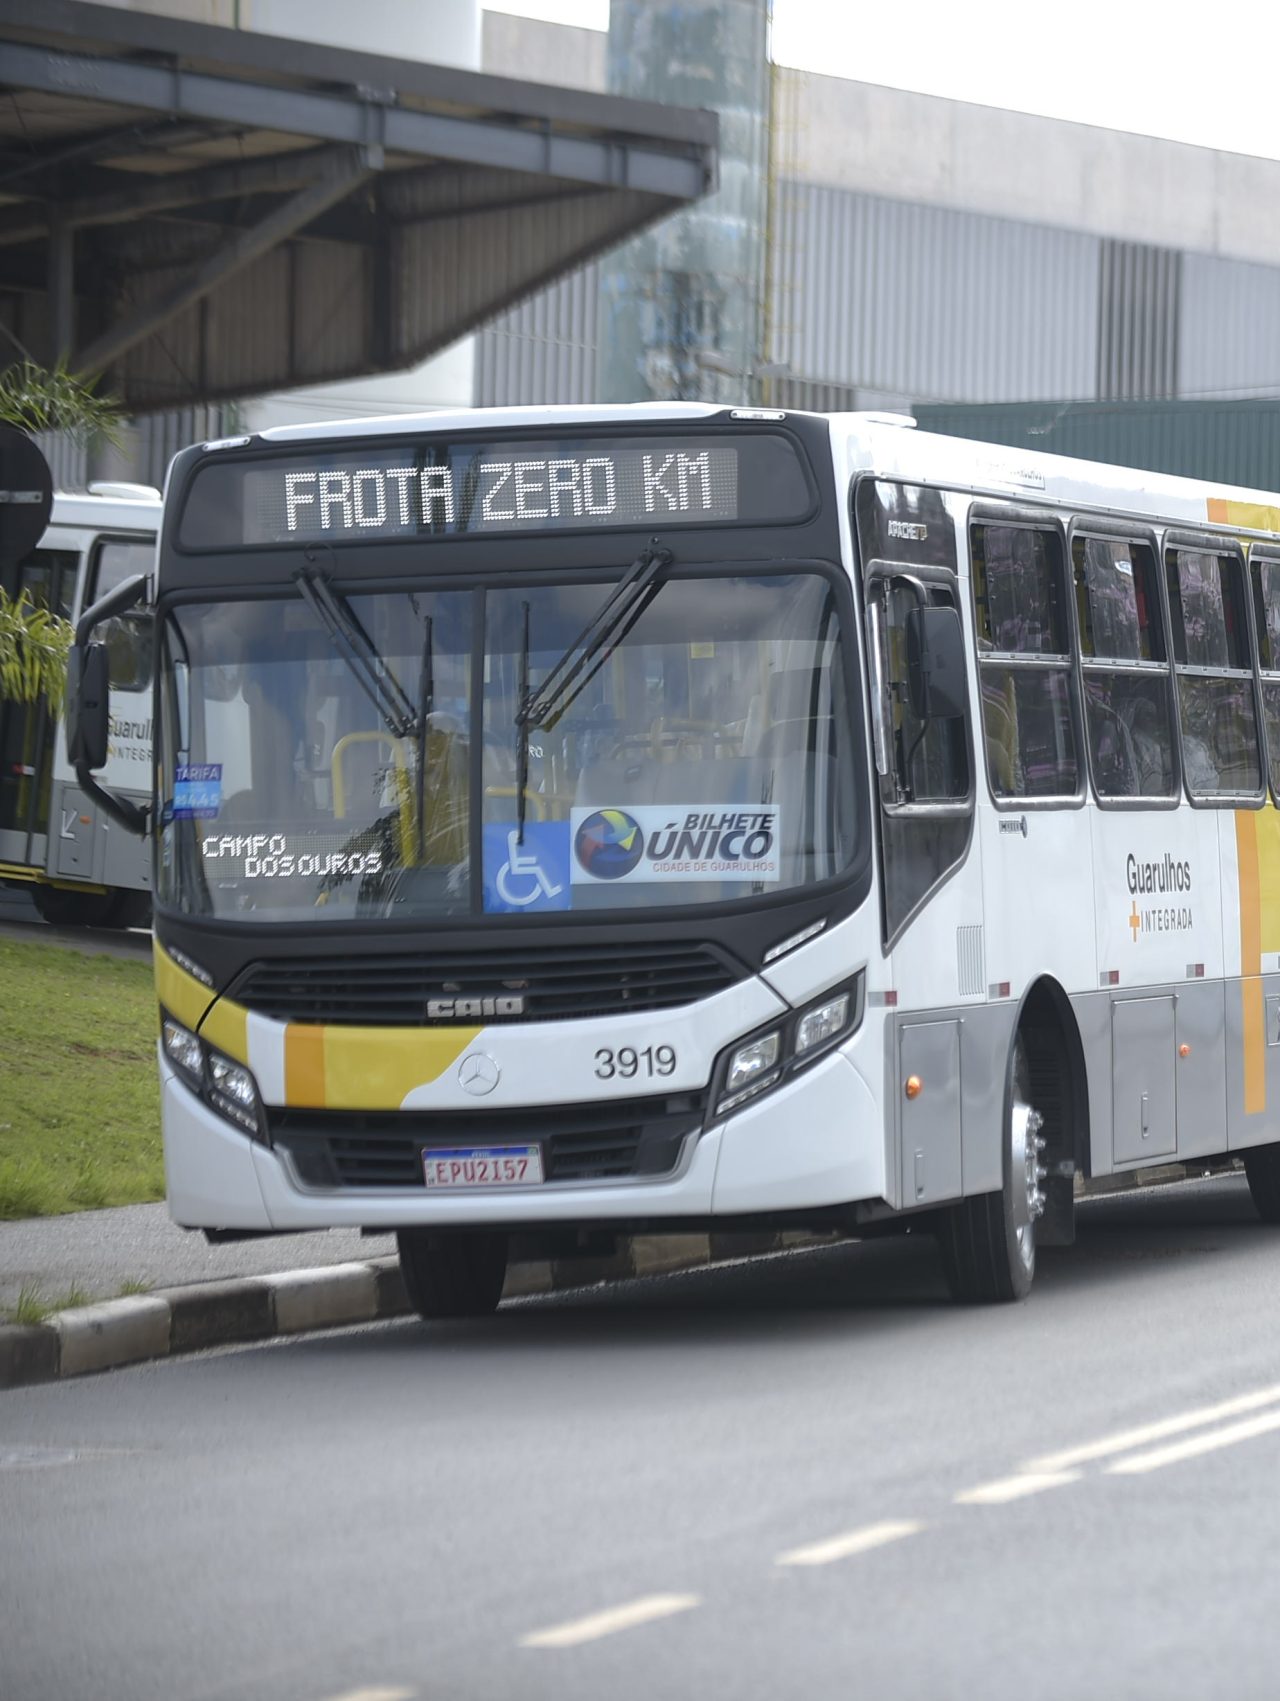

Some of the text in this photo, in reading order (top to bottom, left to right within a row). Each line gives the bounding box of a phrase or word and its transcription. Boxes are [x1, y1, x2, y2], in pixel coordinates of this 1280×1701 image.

[285, 451, 713, 531] FROTA ZERO KM
[175, 767, 220, 781] TARIFA
[683, 813, 776, 831] BILHETE
[202, 833, 287, 858] CAMPO
[646, 823, 774, 862] ÚNICO
[244, 851, 383, 878] DOS OUROS
[653, 861, 775, 873] CIDADE DE GUARULHOS
[1126, 853, 1191, 895] Guarulhos
[1140, 908, 1193, 933] INTEGRADA
[427, 996, 524, 1018] CAIO
[593, 1044, 677, 1081] 3919
